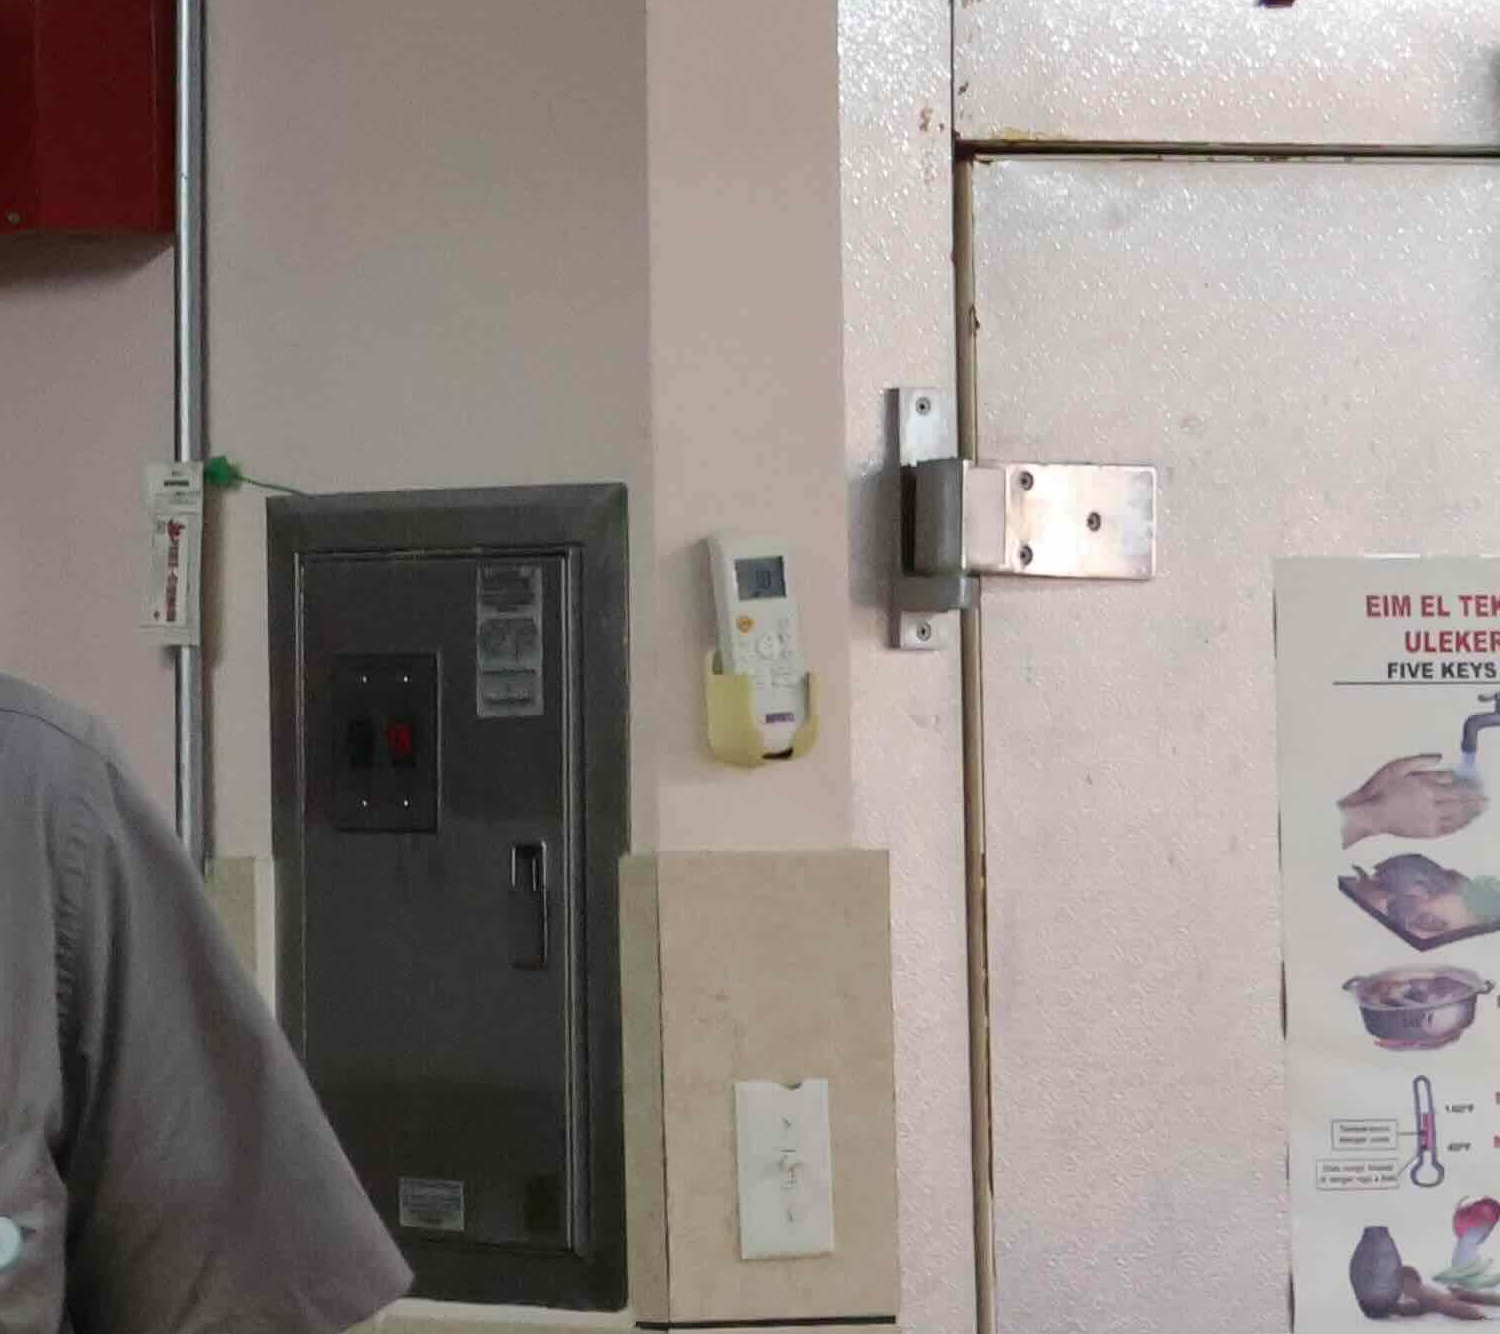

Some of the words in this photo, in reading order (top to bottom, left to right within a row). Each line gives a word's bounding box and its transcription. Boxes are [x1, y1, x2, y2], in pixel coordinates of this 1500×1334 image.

[1366, 594, 1412, 618] EIM
[1421, 594, 1451, 618] EL
[1387, 662, 1434, 679] FIVE
[1441, 662, 1497, 679] KEYS
